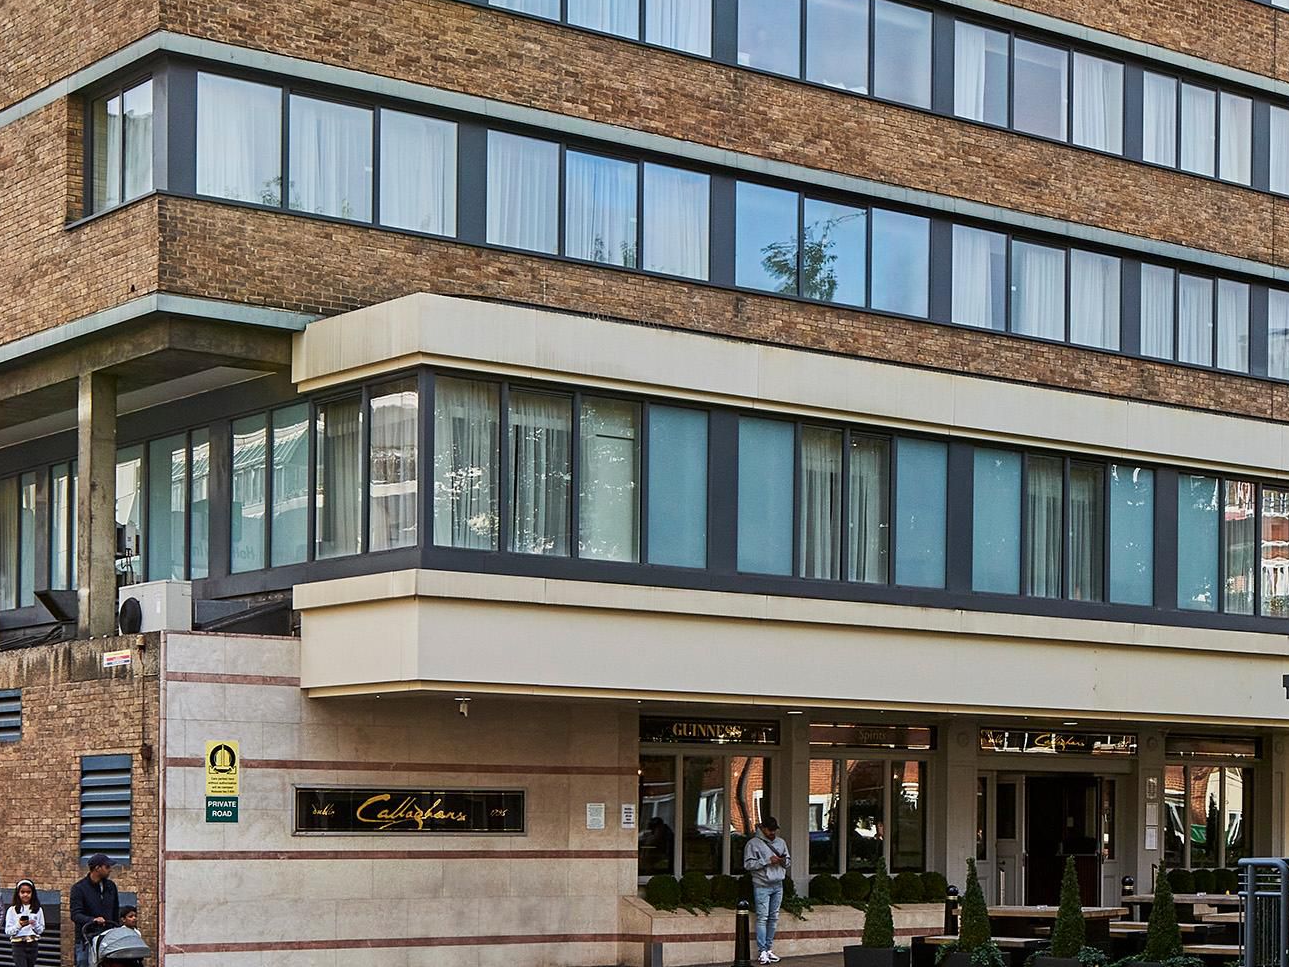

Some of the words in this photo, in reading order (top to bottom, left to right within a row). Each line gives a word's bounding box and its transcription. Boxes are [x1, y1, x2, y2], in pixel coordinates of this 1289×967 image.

[672, 722, 742, 738] GUINNESS
[207, 800, 237, 808] PRIVATE
[356, 794, 466, 830] Callaghans
